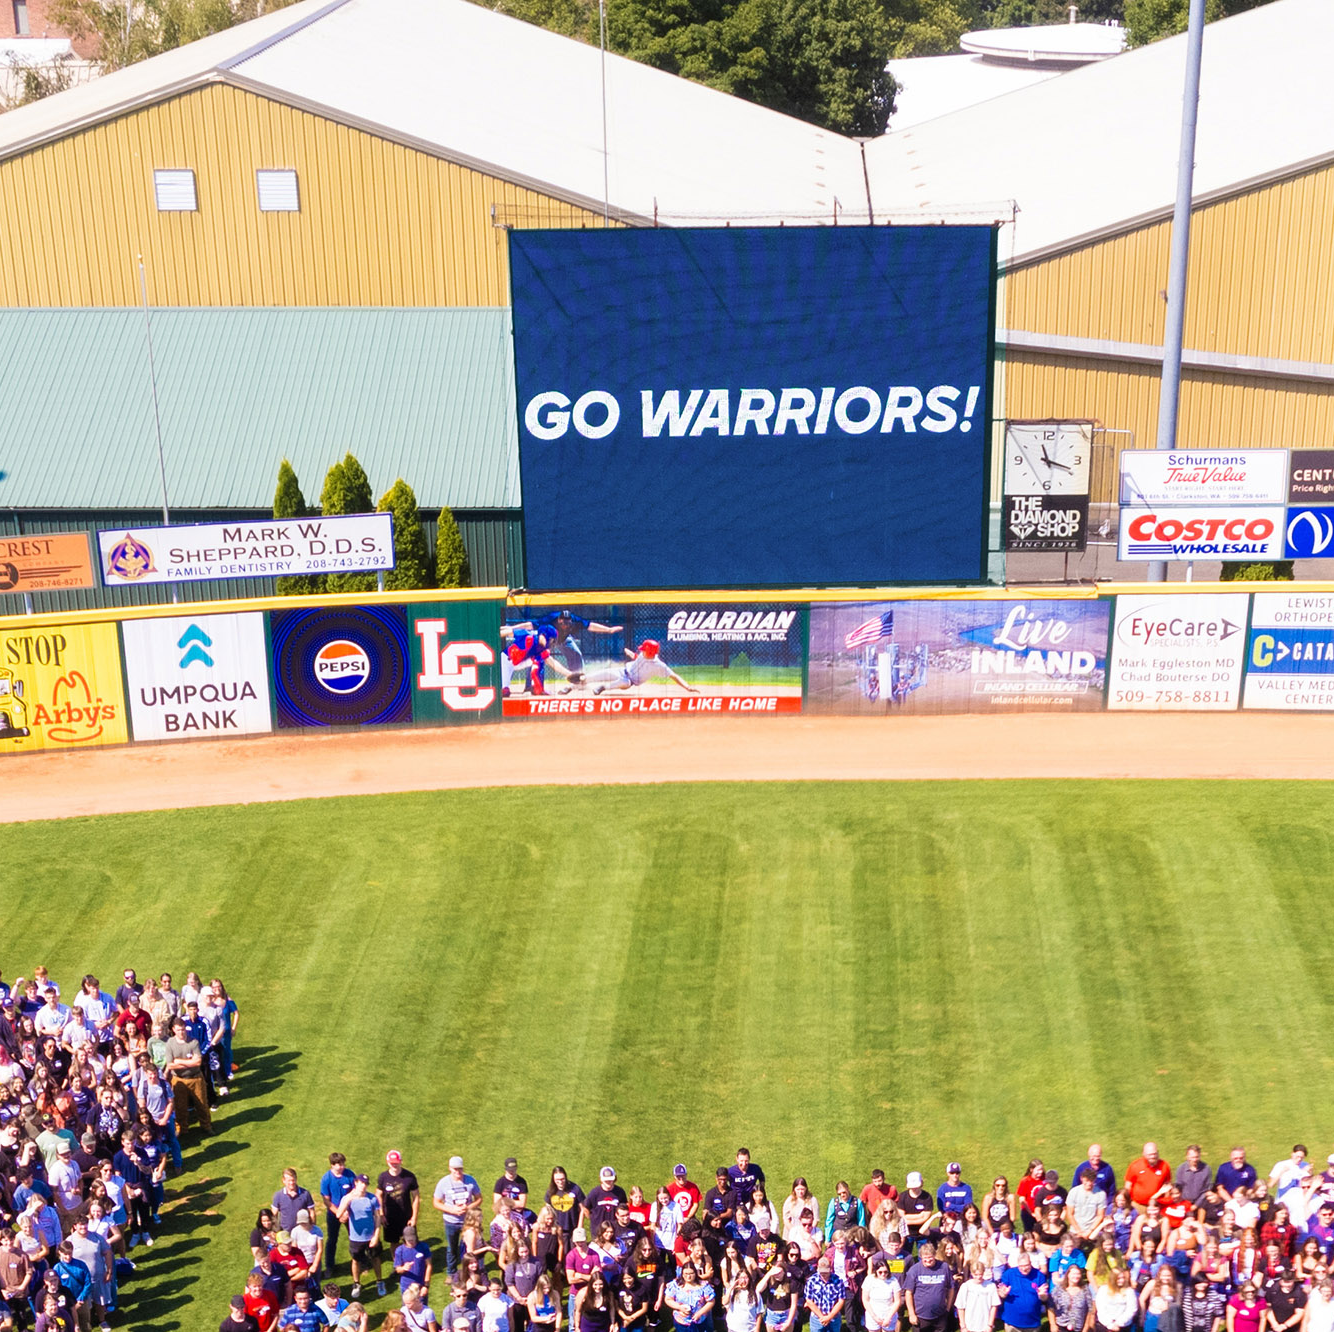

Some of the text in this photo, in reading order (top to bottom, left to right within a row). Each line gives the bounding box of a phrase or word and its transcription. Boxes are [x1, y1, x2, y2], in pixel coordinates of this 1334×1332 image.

[525, 386, 980, 440] GO WARRIORS!
[1044, 431, 1055, 440] 12
[1014, 456, 1082, 465] 9 3
[1168, 454, 1246, 466] Schurmans
[1043, 481, 1051, 491] 6
[1292, 485, 1314, 493] Price
[1012, 497, 1043, 510] THE
[1011, 510, 1081, 524] DIAMOND
[297, 522, 328, 538] W.
[1037, 523, 1079, 537] SHOP
[1128, 514, 1274, 542] COSTCO
[309, 537, 383, 556] D.D.S.
[1172, 543, 1269, 555] WHOLESALE
[167, 556, 387, 577] FAMILY DENTISTRY 208-743-2792
[668, 610, 797, 630] GUARDIAN
[993, 605, 1073, 651] Live
[1131, 618, 1217, 645] EyeCare
[667, 632, 710, 641] PLUMBING,
[712, 632, 746, 641] HEATING
[747, 632, 753, 641] &
[771, 632, 787, 641] INC.
[6, 633, 67, 668] STOP
[319, 661, 366, 673] PEPSI
[414, 618, 496, 712] LC
[970, 650, 1097, 675] INLAND
[1118, 658, 1235, 672] Mark Eggleston MD
[1121, 672, 1230, 683] Chad Bouterse DO
[1257, 680, 1305, 691] VALLEY
[141, 681, 258, 707] UMPQUA
[1116, 690, 1230, 704] 509-758-8811
[1285, 693, 1334, 705] CENTER
[529, 697, 778, 713] THERE'S NO PLACE LIKE HOME
[32, 702, 116, 732] Arby's
[165, 709, 238, 733] BANK
